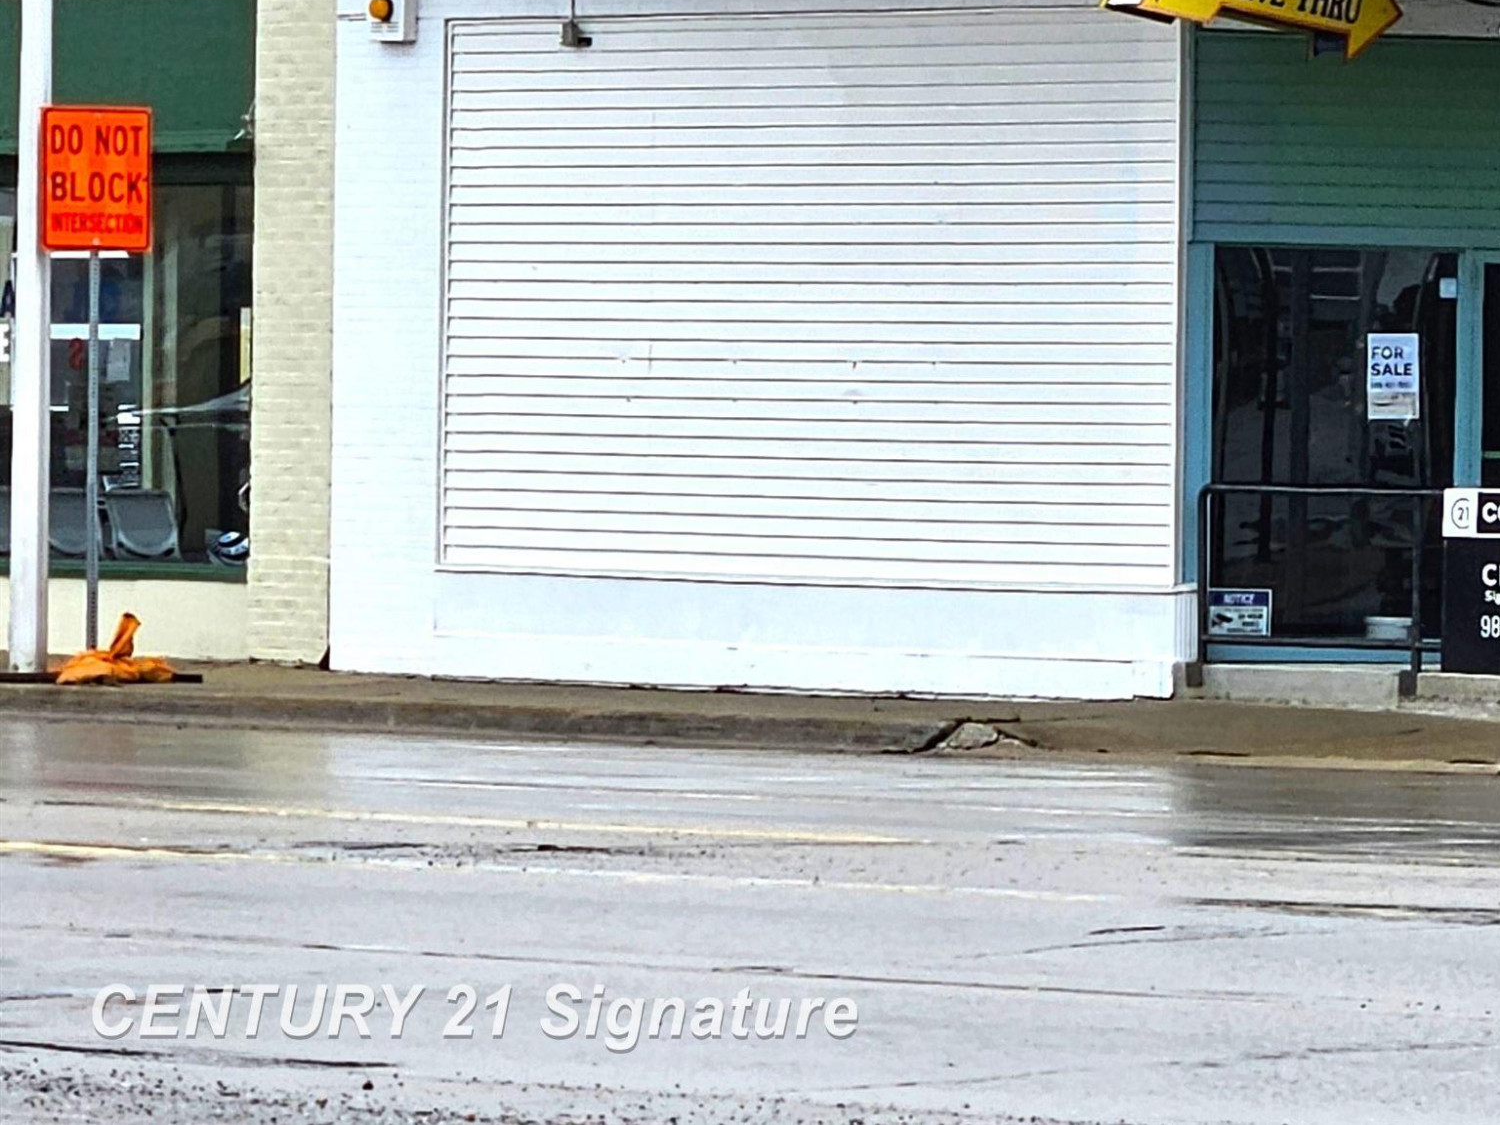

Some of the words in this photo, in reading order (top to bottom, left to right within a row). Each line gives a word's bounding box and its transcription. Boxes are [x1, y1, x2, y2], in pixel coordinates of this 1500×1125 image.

[51, 124, 83, 155] DO
[95, 125, 143, 157] NOT
[51, 171, 143, 204] BLOCK
[51, 212, 143, 234] INTERSECTION
[1371, 346, 1404, 360] FOR
[1371, 363, 1413, 376] SALE
